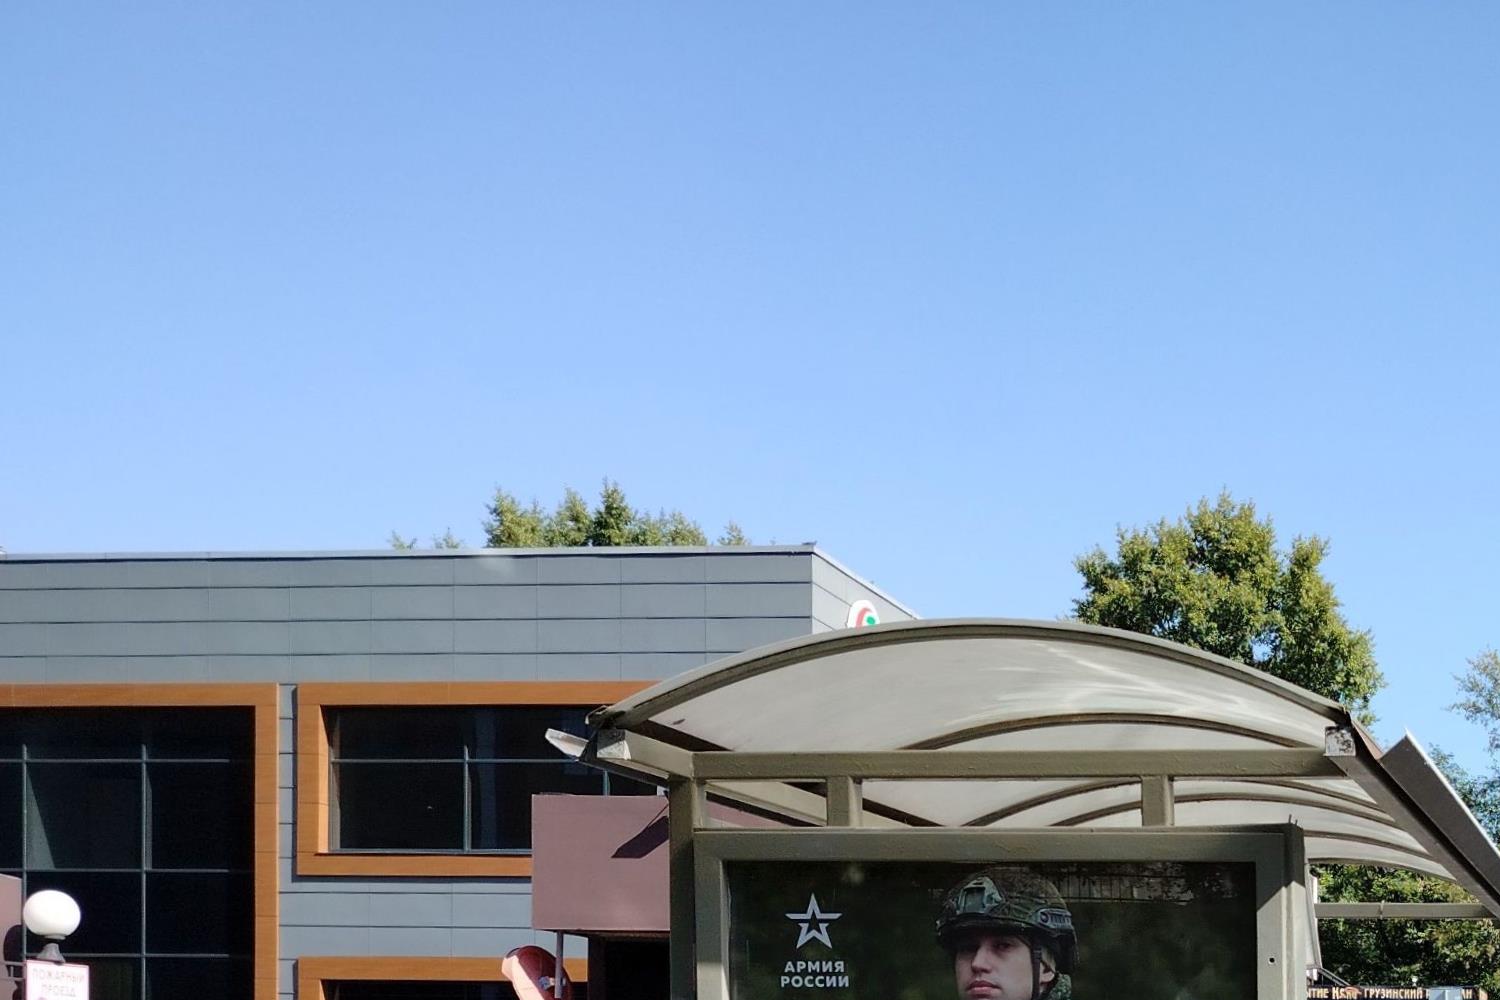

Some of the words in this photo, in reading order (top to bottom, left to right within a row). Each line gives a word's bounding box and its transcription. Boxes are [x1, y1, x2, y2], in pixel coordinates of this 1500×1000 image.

[784, 960, 845, 973] АРМИЯ
[780, 975, 849, 988] РОССИИ
[1364, 987, 1423, 1000] ГРУЗИНСКИЙ
